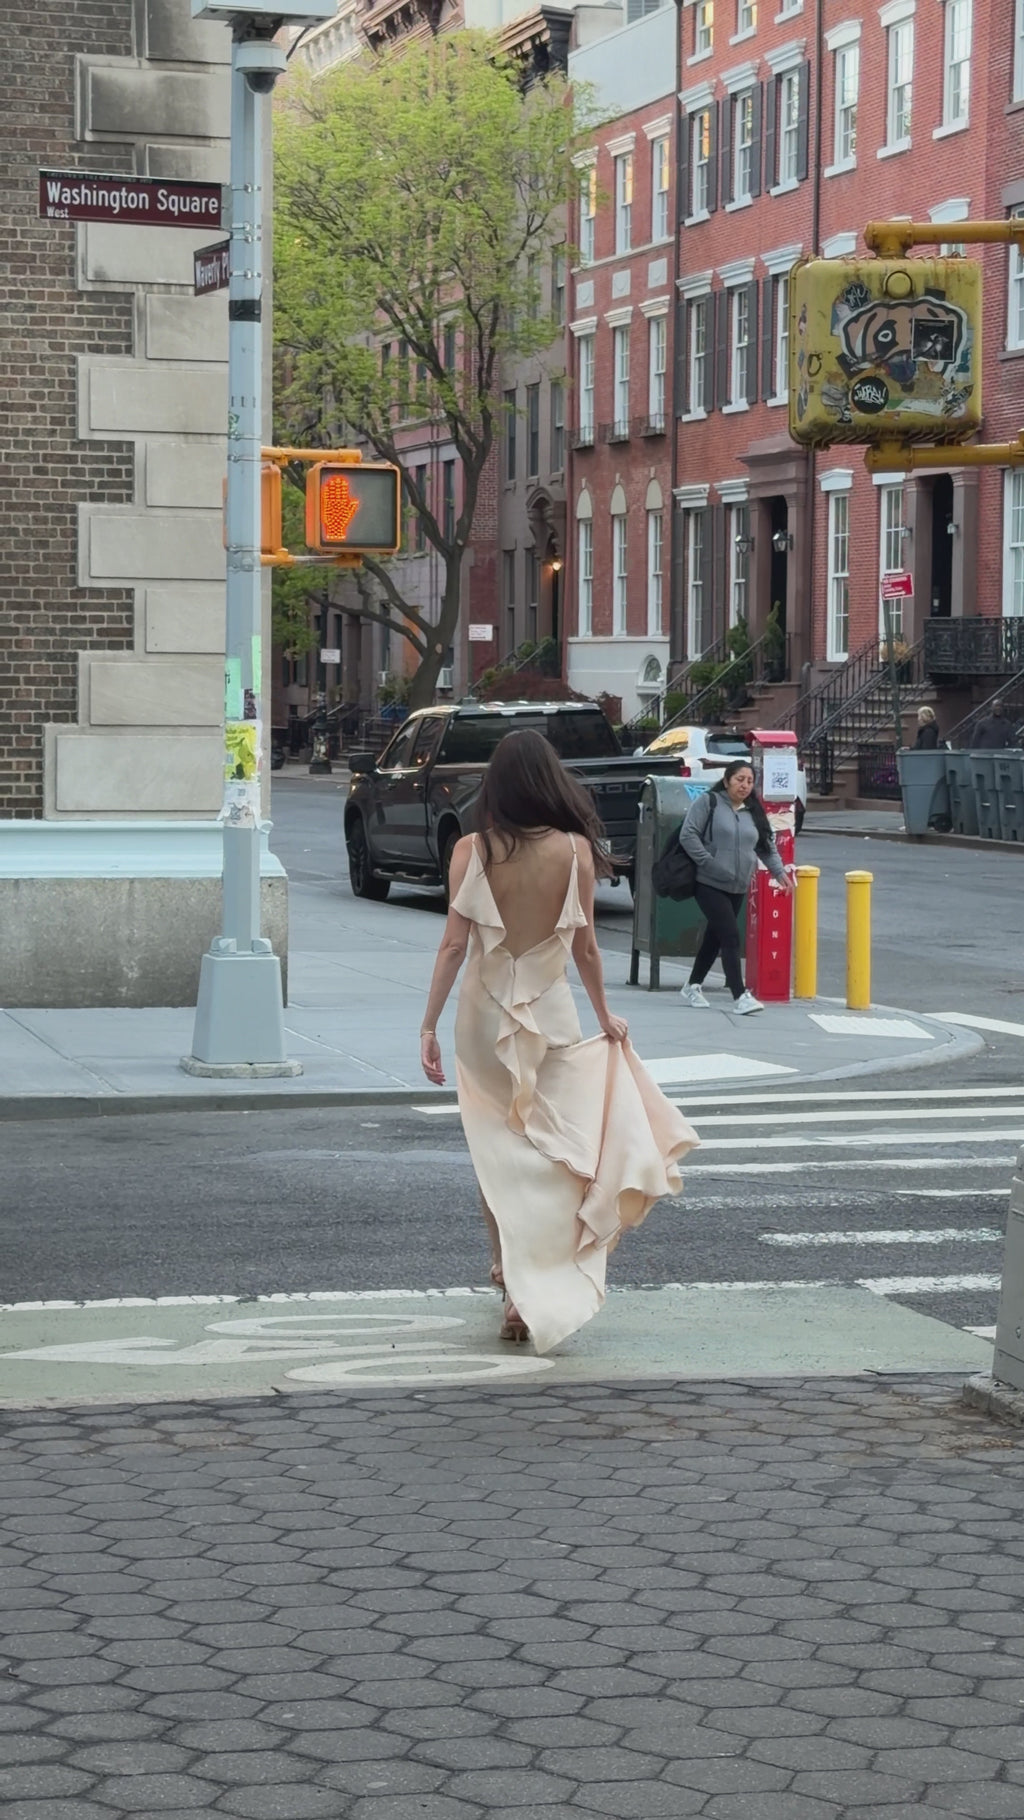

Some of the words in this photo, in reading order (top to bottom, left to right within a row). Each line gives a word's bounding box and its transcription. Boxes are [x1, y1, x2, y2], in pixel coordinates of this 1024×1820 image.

[46, 181, 149, 214] Washington
[157, 188, 219, 216] Square
[46, 206, 70, 218] West
